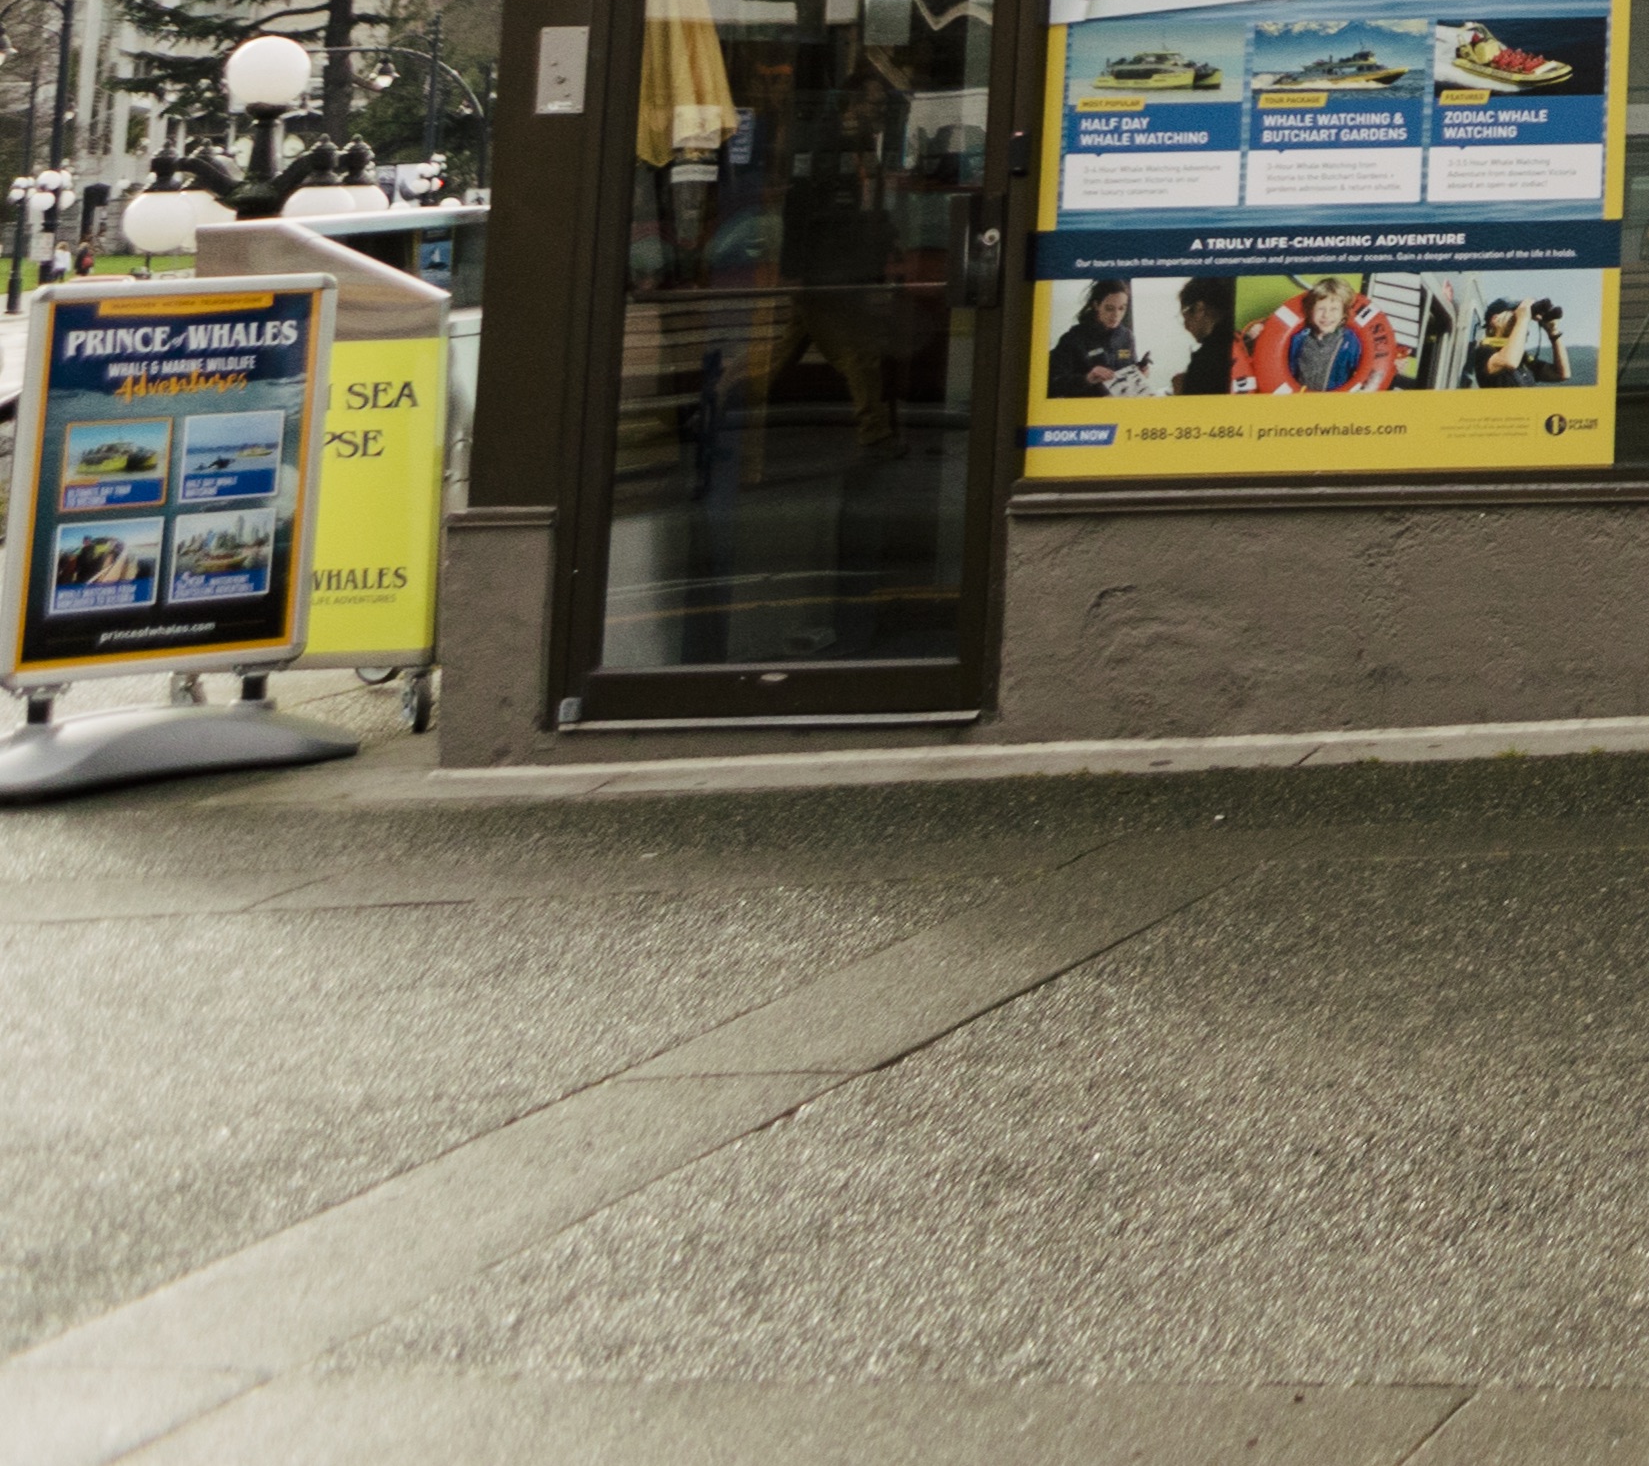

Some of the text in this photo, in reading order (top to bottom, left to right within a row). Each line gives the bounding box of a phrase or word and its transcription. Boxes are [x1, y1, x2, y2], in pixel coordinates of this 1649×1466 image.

[1081, 117, 1150, 131] HALF DAY
[1263, 112, 1404, 127] WHALE WATCHING &
[1443, 109, 1548, 124] ZODIAC WHALE
[1080, 131, 1209, 146] WHALE WATCHING
[1262, 127, 1407, 143] BUTCHART GARDENS
[1443, 125, 1517, 139] WATCHING
[1190, 233, 1466, 250] A TRULY LIFE-CHANGING ADVENTURE
[66, 320, 298, 357] PRINCE WHALES
[207, 355, 257, 372] WILDLIFE
[114, 371, 248, 404] Adventures
[346, 381, 419, 410] SEA
[1043, 423, 1407, 443] BOOK NOW 1-888-383-4884 princeofwhales.com
[100, 622, 216, 645] princeofwhales.com
